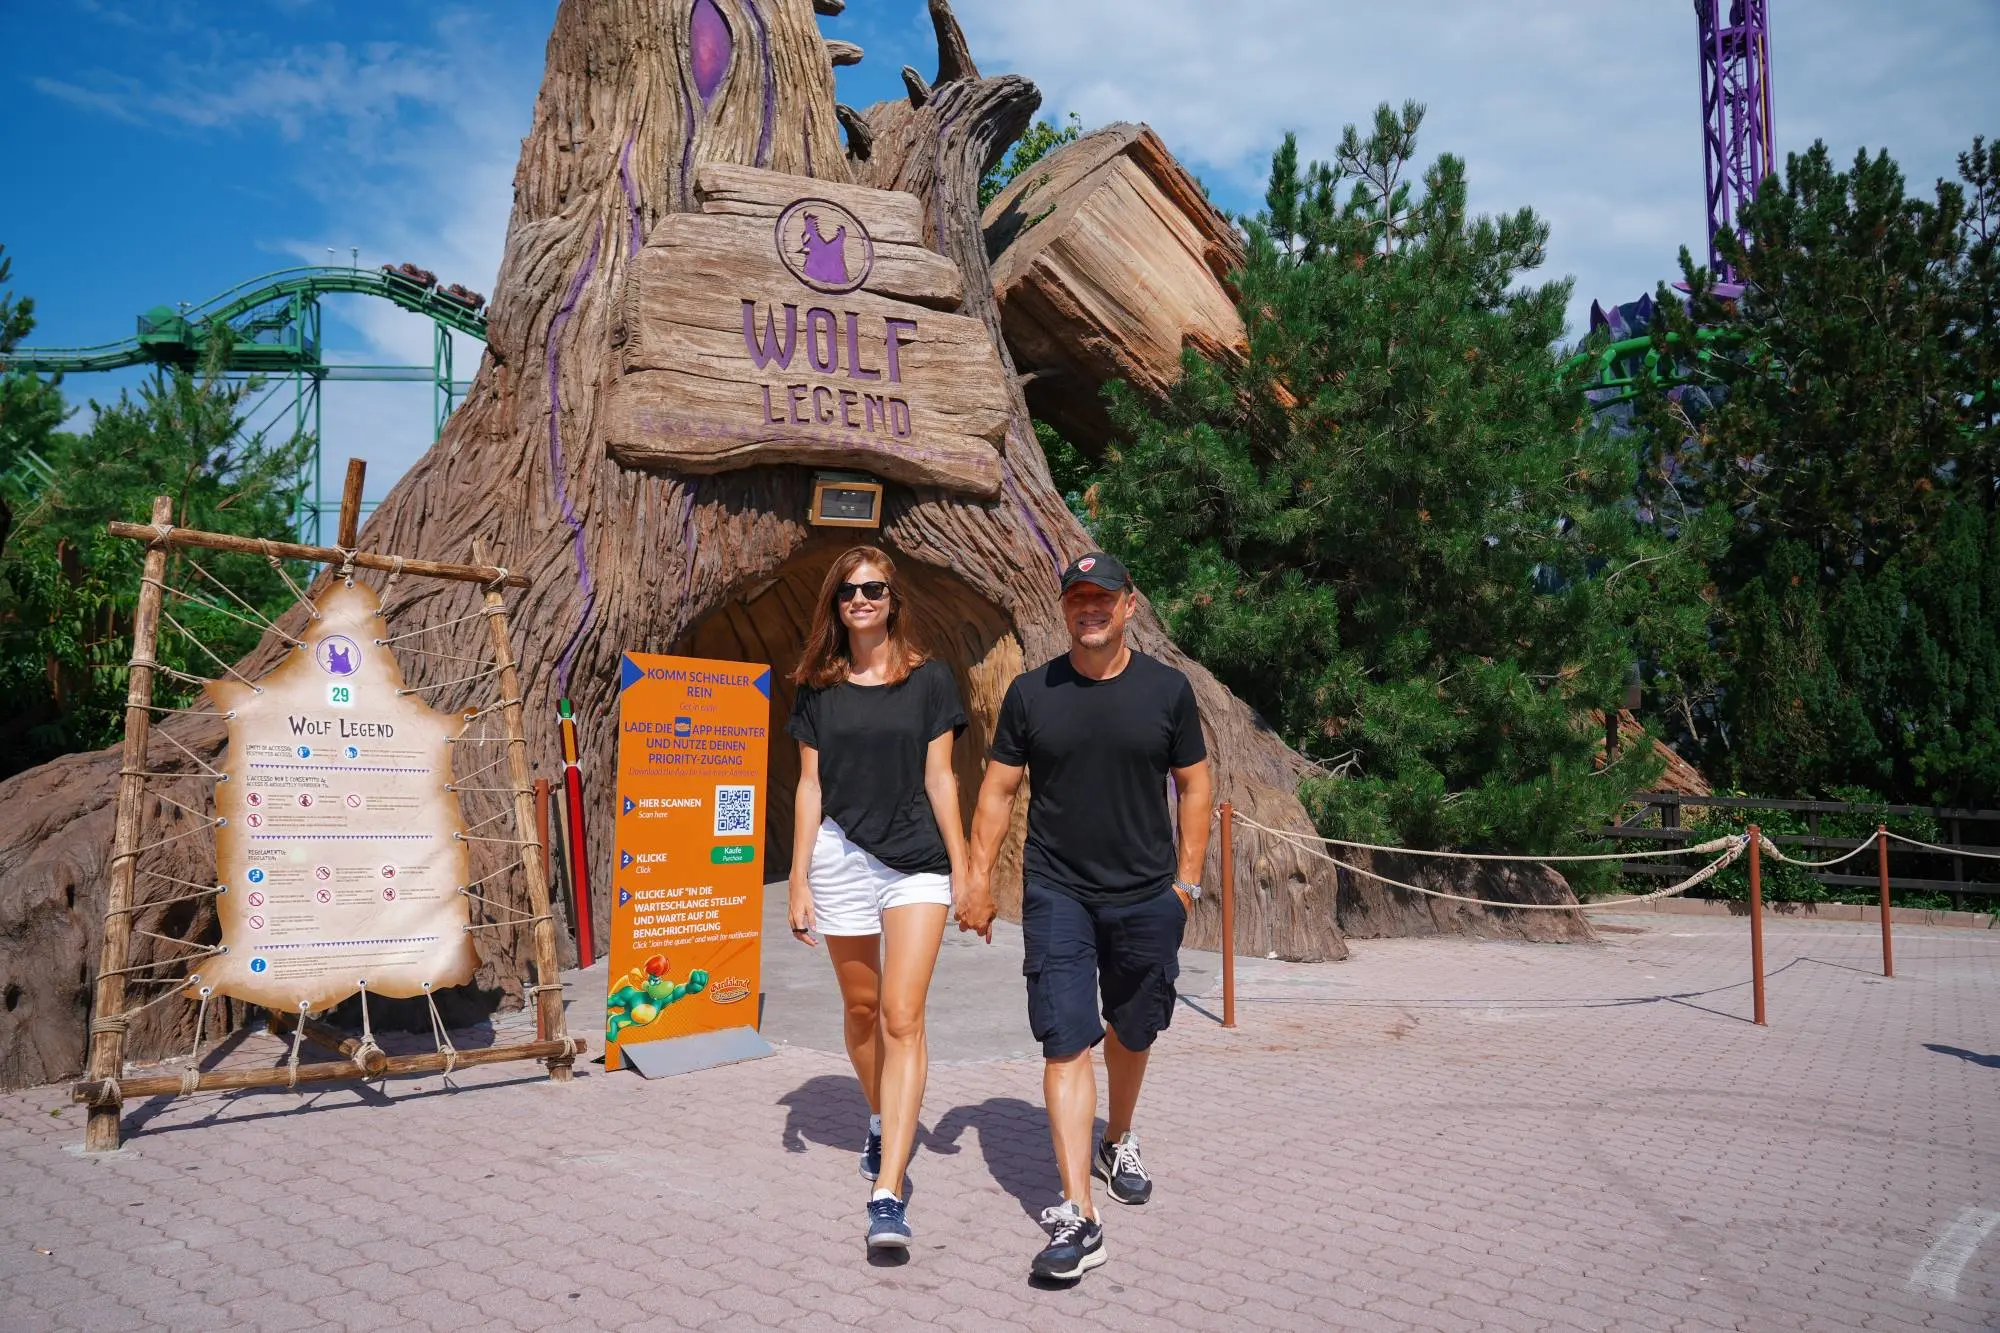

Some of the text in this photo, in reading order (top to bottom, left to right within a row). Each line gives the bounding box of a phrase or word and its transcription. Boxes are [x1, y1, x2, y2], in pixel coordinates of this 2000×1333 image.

[741, 298, 917, 383] WOLF
[760, 383, 911, 438] LEGEND
[647, 668, 750, 687] KOMM SCHNELLER
[332, 687, 350, 702] 29
[687, 686, 712, 698] REIN
[624, 721, 652, 733] LADE
[655, 722, 672, 734] DIE
[692, 724, 712, 736] APP
[714, 725, 765, 738] HERUNTER
[646, 738, 746, 751] UND NUTZE DEINEN
[648, 753, 743, 766] PRIORITY-ZUGANG
[639, 799, 660, 808] HIER
[661, 798, 702, 808] SCANNEN
[623, 853, 668, 864] 2 KLICKE
[621, 892, 627, 901] 3
[634, 889, 666, 900] KLICKE
[666, 887, 684, 898] AUF
[699, 886, 713, 896] DIE
[634, 897, 710, 913] WARTESCHLANGE
[633, 910, 719, 926] UND WARTE AUF DIE
[633, 922, 721, 939] BENACHRICHTIGUNG
